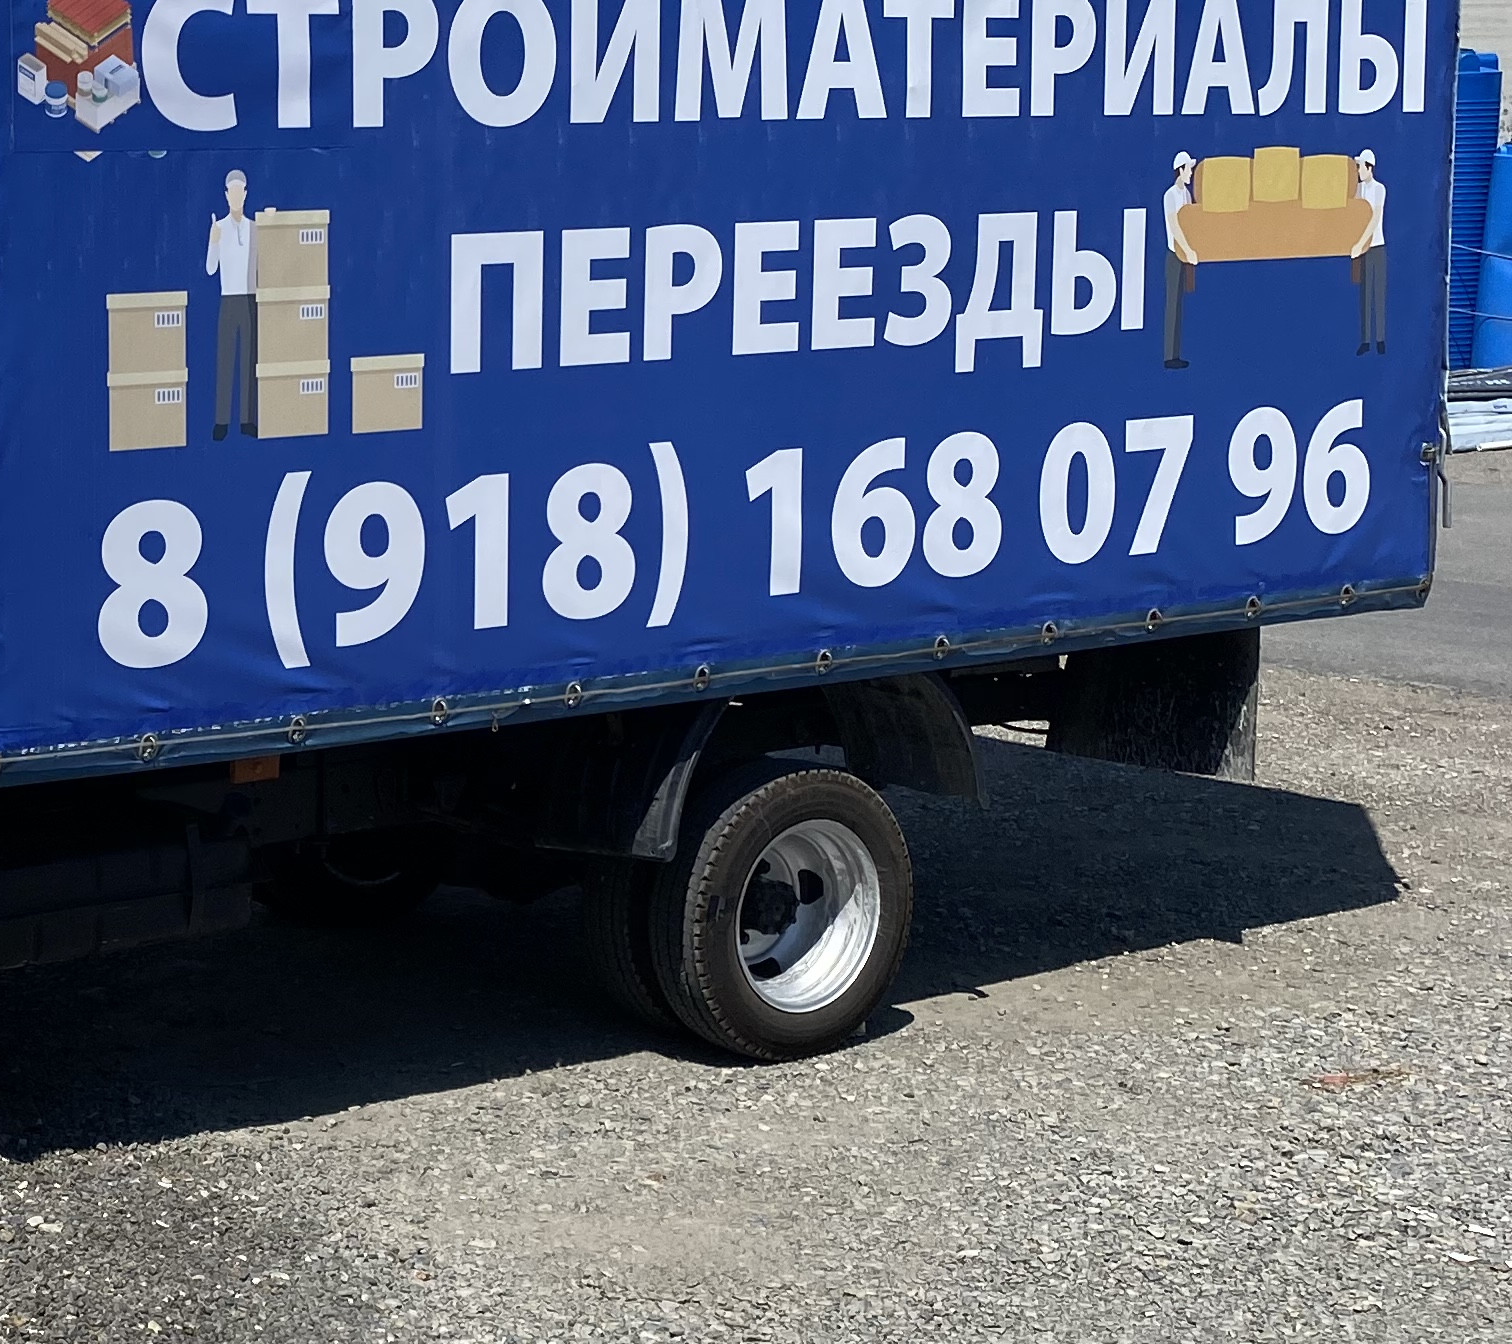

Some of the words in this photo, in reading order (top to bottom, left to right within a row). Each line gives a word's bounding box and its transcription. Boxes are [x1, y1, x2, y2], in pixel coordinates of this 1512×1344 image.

[451, 208, 1147, 374] ПЕРЕЕЗДЫ
[98, 500, 208, 669] 8
[265, 442, 689, 668] (918)
[746, 432, 1003, 597] 168
[1040, 415, 1194, 565] 07
[1229, 399, 1371, 546] 96
